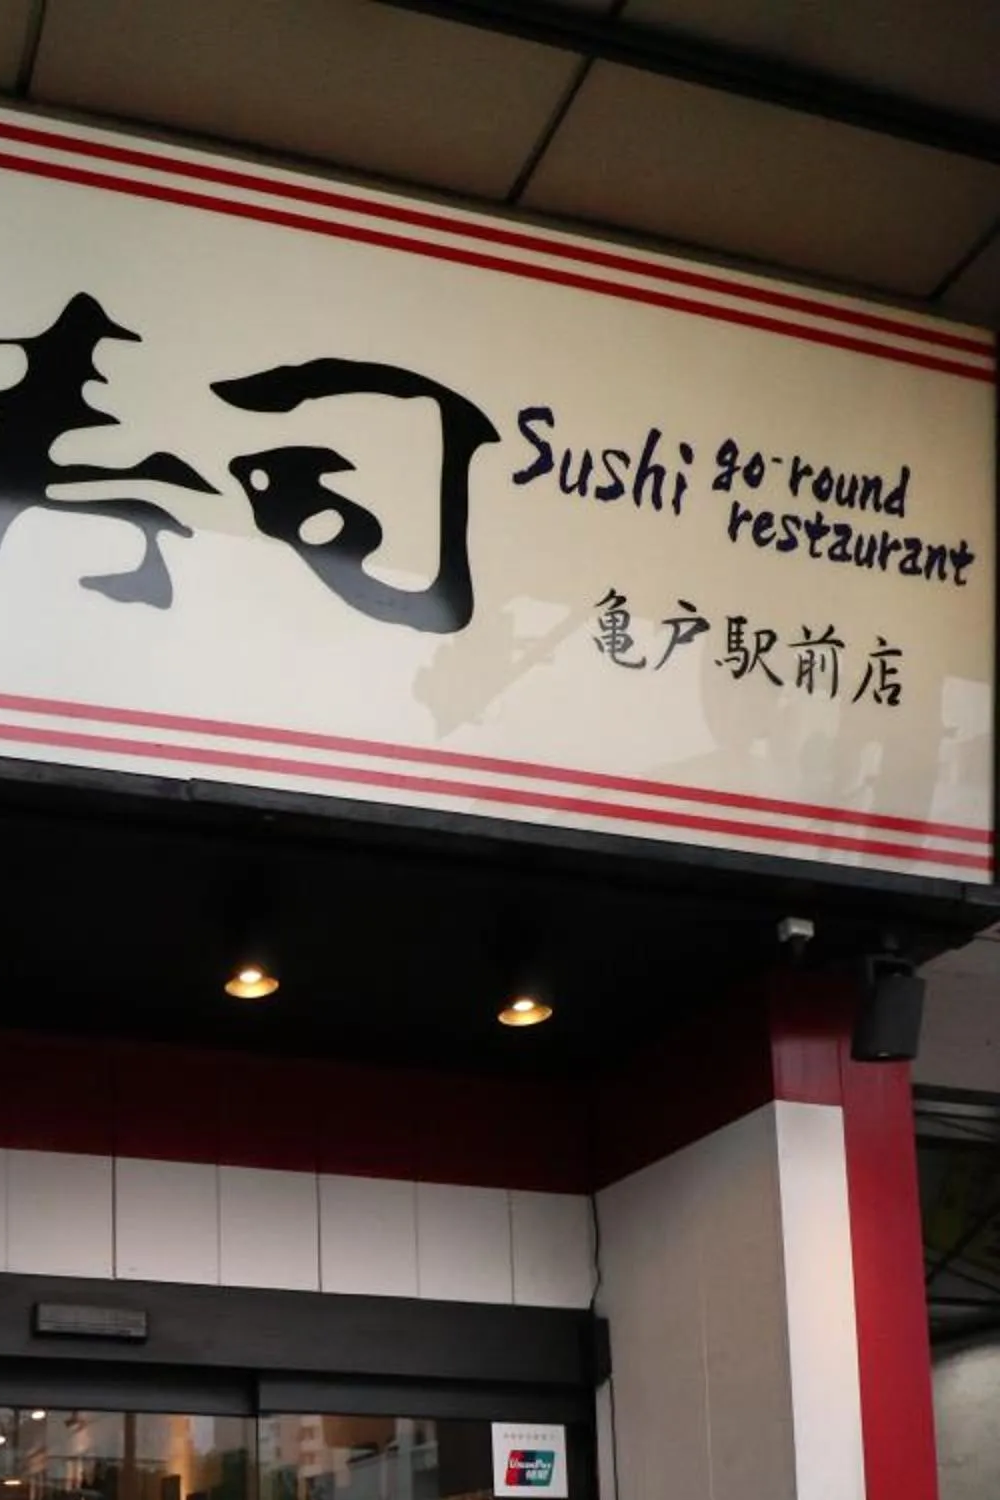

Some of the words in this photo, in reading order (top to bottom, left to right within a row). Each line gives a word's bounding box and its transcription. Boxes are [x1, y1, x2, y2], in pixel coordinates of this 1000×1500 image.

[512, 406, 694, 514] Sushi
[728, 501, 976, 588] restaurant
[594, 588, 905, 708] 亀戸駅前店
